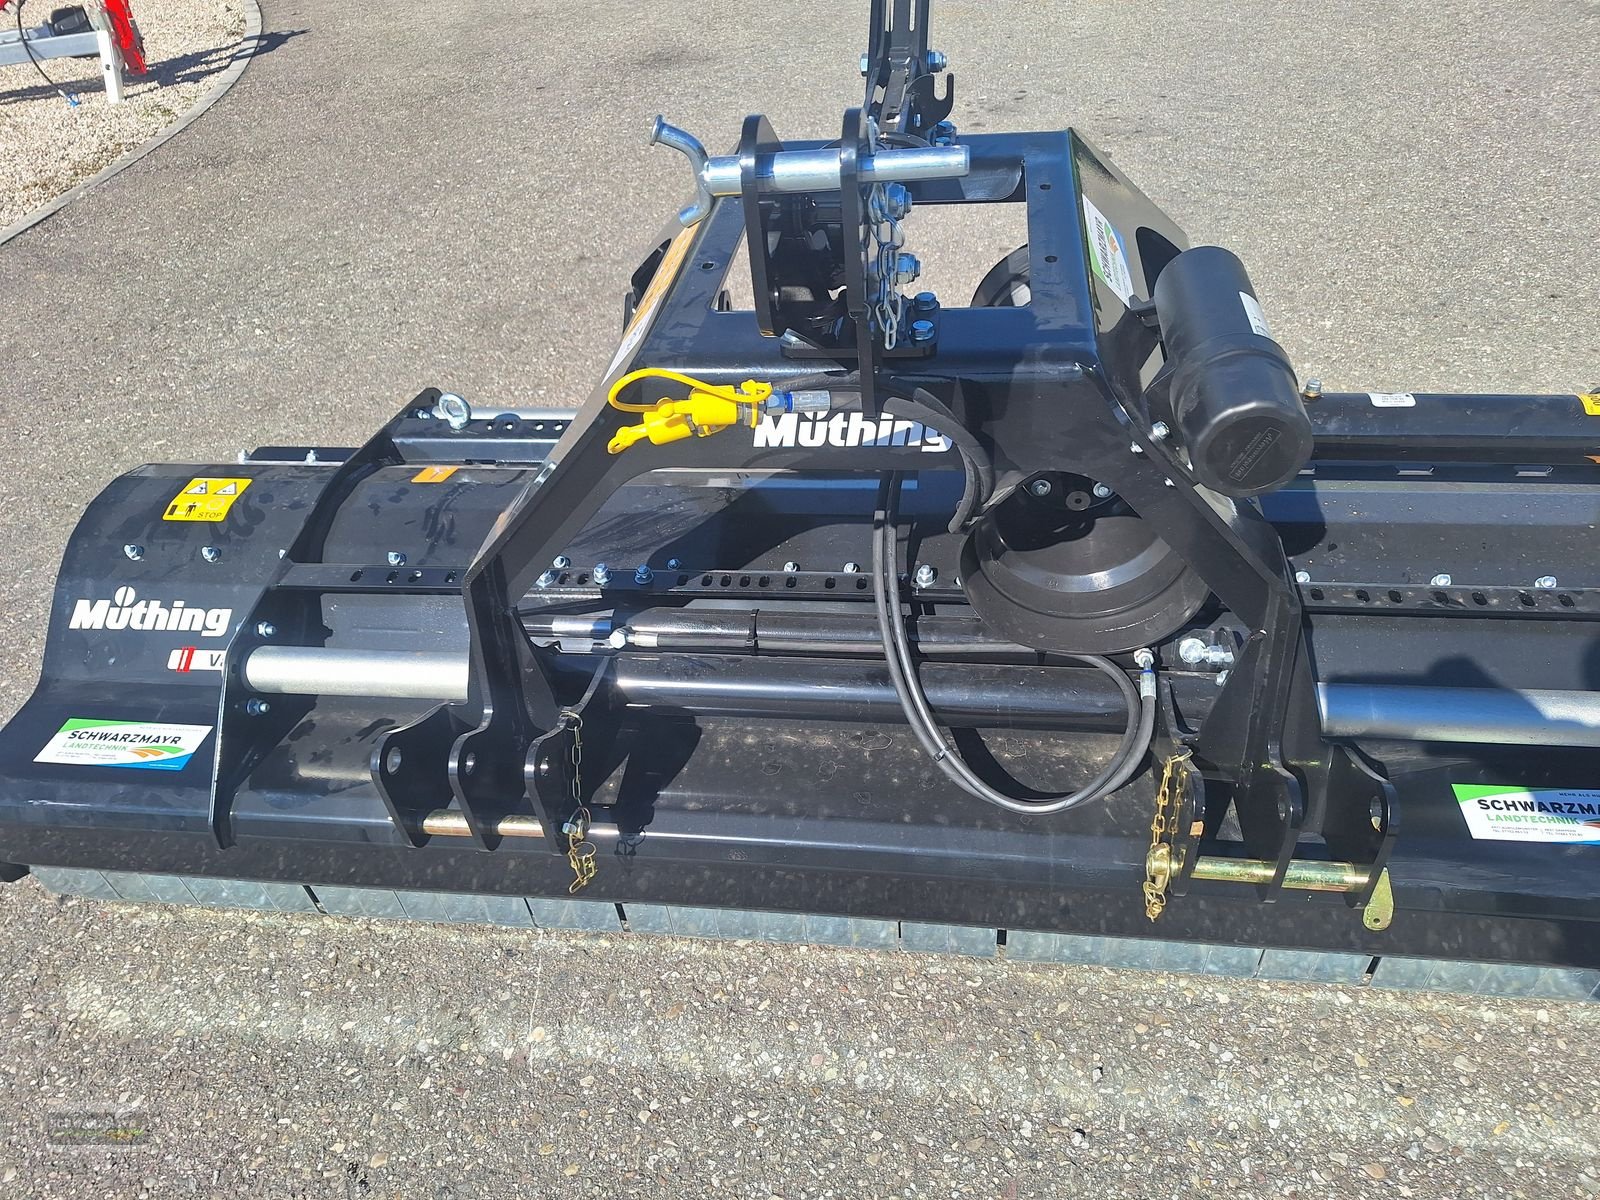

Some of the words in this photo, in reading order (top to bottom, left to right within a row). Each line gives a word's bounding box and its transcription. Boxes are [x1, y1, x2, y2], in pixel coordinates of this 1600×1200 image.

[197, 511, 223, 519] STOP
[68, 585, 233, 637] Müthing
[68, 730, 182, 745] SCHWARZMAYR
[62, 742, 129, 752] LANDTECHNIK
[1486, 814, 1580, 825] LANDTECHNIK
